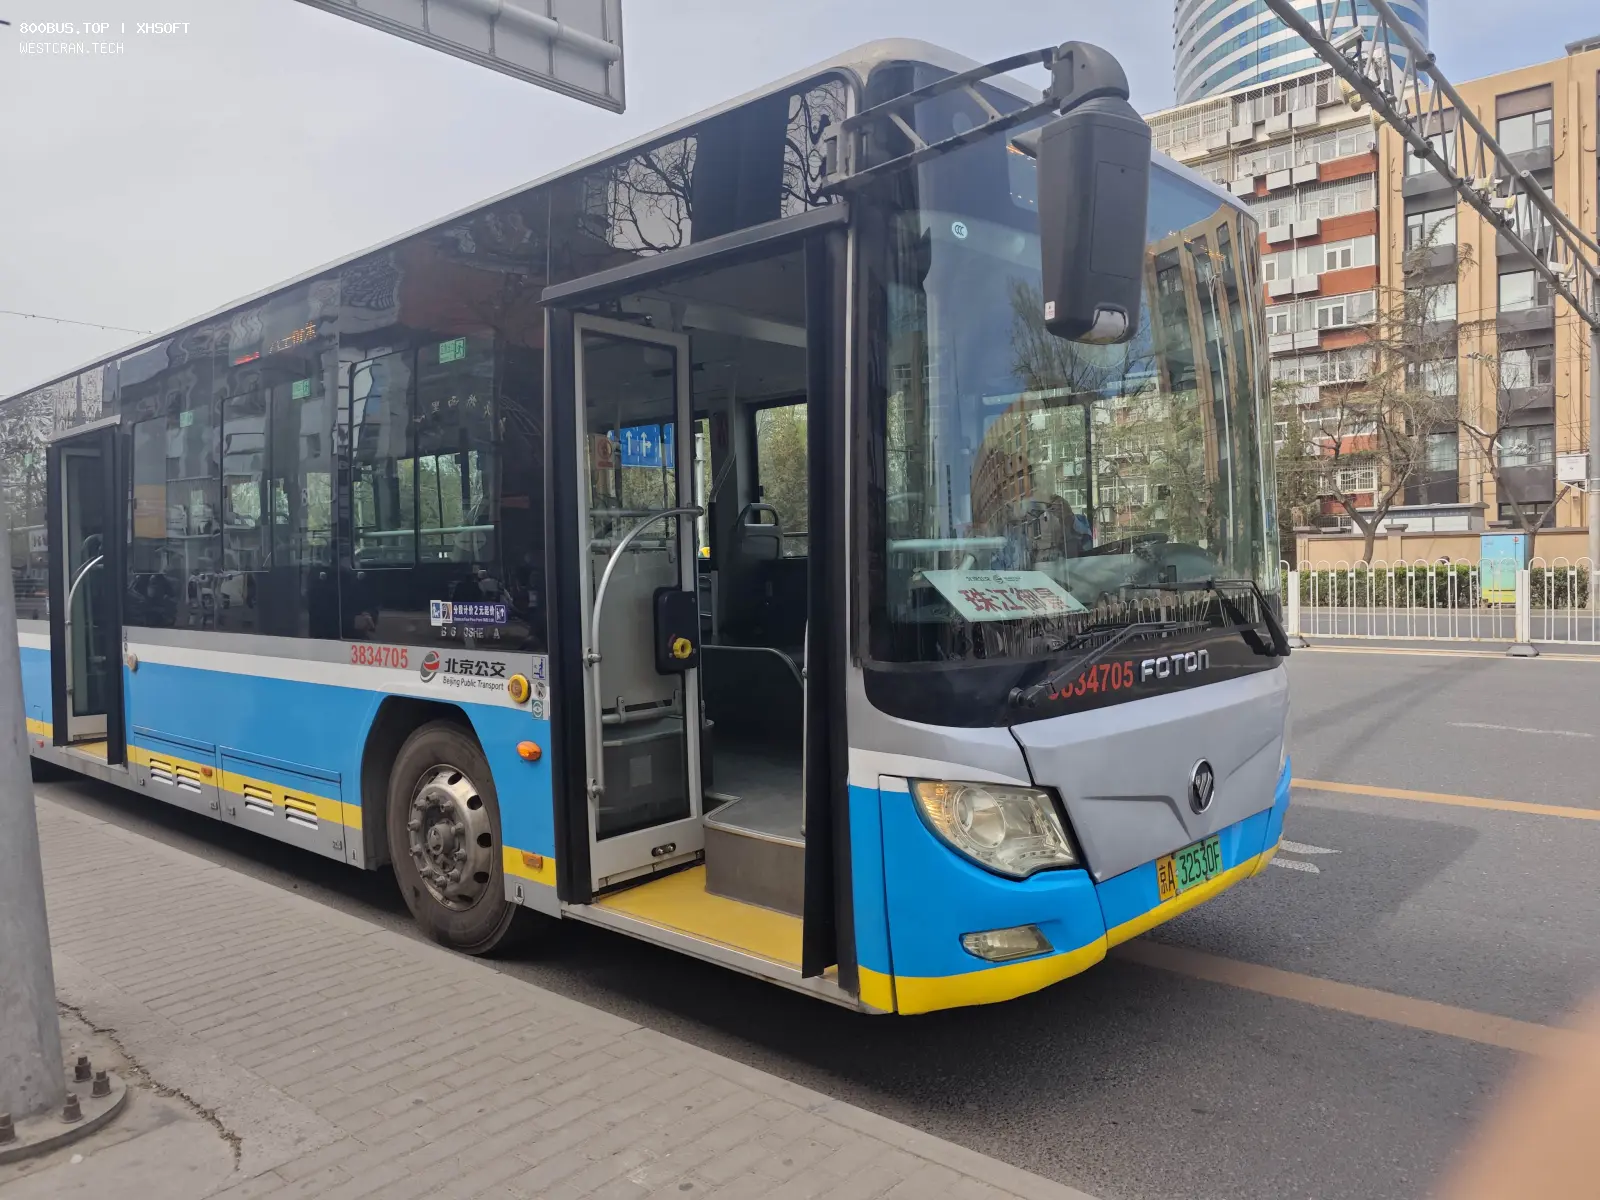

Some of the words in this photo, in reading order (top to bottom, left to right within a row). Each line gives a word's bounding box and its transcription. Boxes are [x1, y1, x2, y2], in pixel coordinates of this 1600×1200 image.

[351, 644, 409, 668] 3834705
[444, 658, 506, 678] 北京公交
[1140, 649, 1210, 682] FOTON
[442, 676, 460, 688] Beijing
[461, 677, 476, 688] Public
[477, 679, 504, 691] Transport
[1048, 660, 1135, 700] 34705
